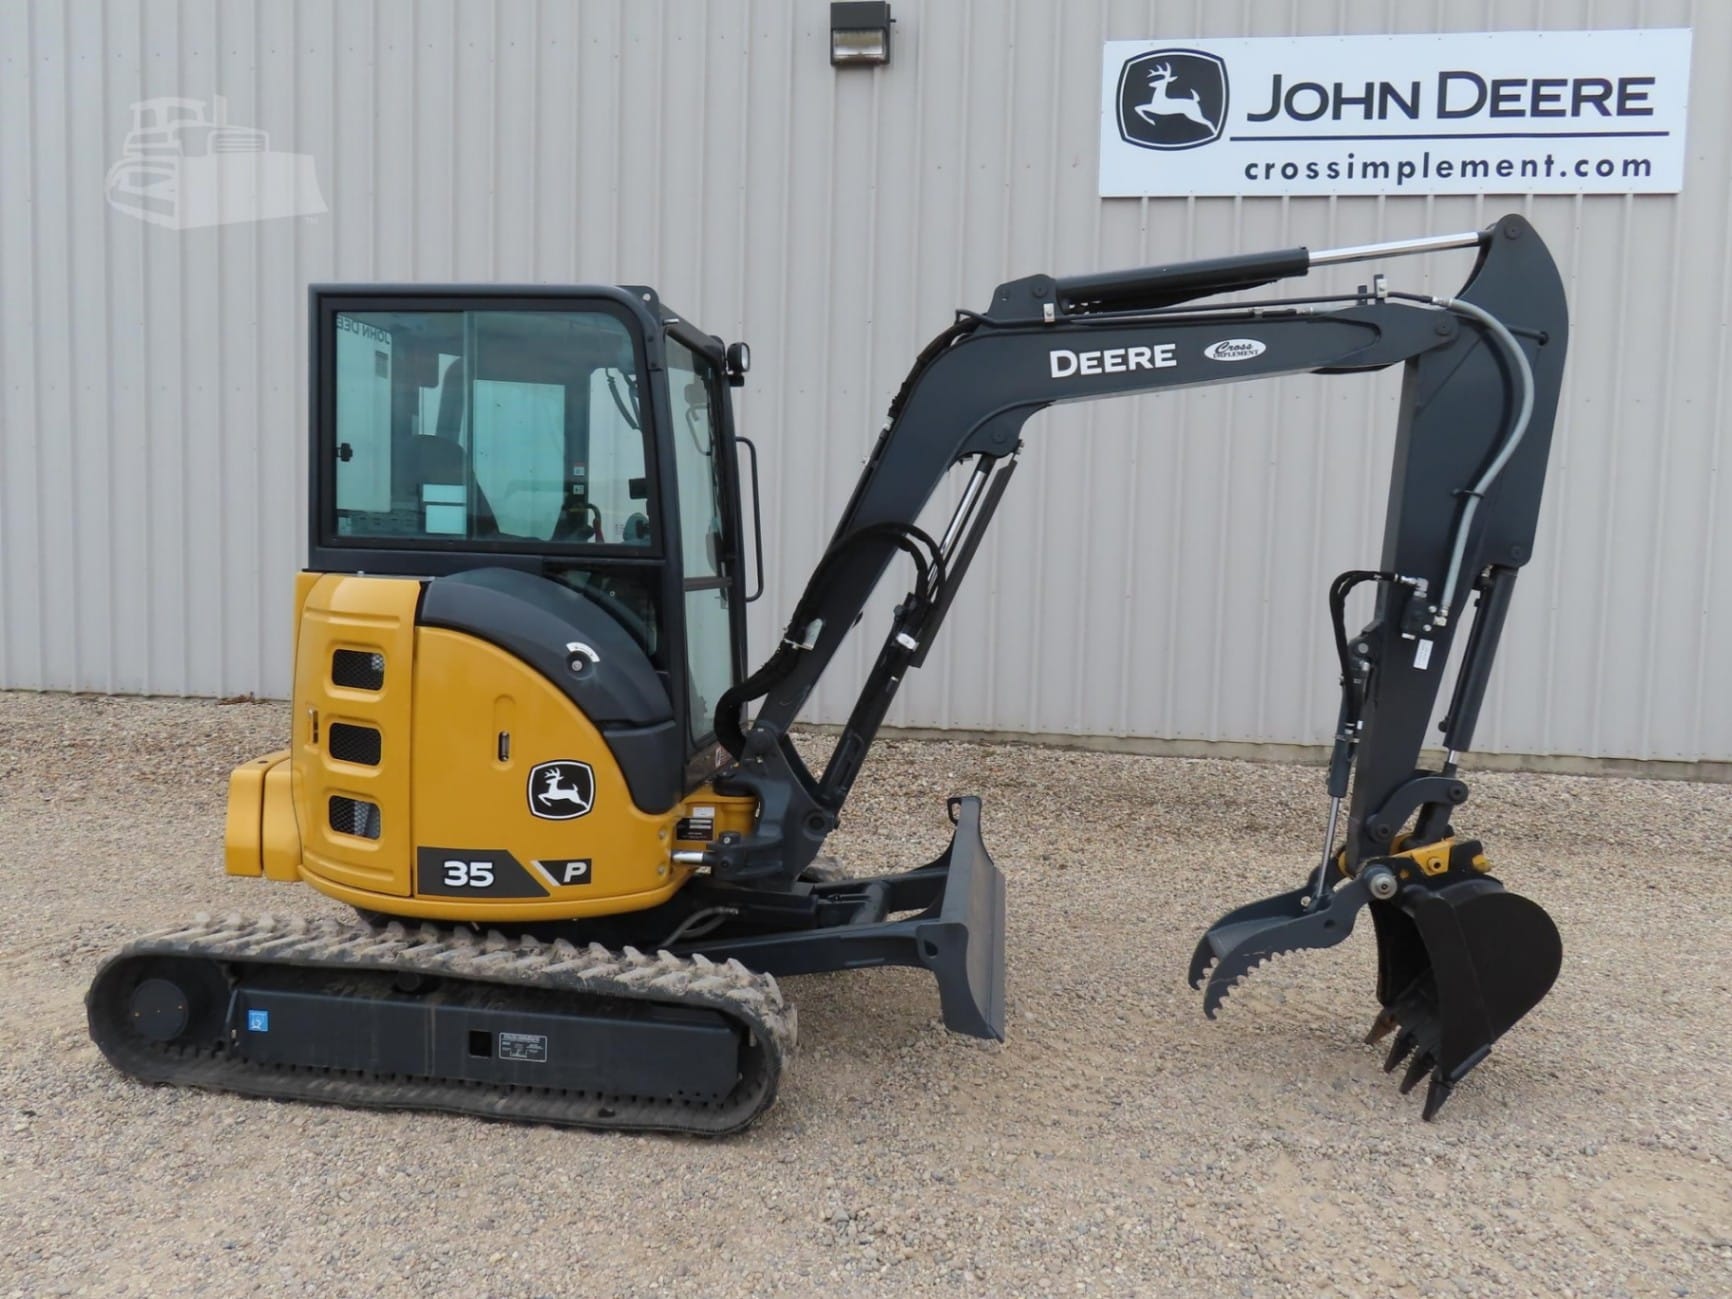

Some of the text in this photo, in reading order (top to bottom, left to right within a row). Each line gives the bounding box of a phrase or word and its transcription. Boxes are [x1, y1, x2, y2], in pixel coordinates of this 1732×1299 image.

[1247, 71, 1656, 122] JOHN DEERE
[1244, 152, 1652, 185] crossimplement.com
[1050, 343, 1177, 378] DEERE
[1214, 341, 1252, 353] Cross
[444, 860, 494, 887] 35
[563, 862, 587, 883] P
